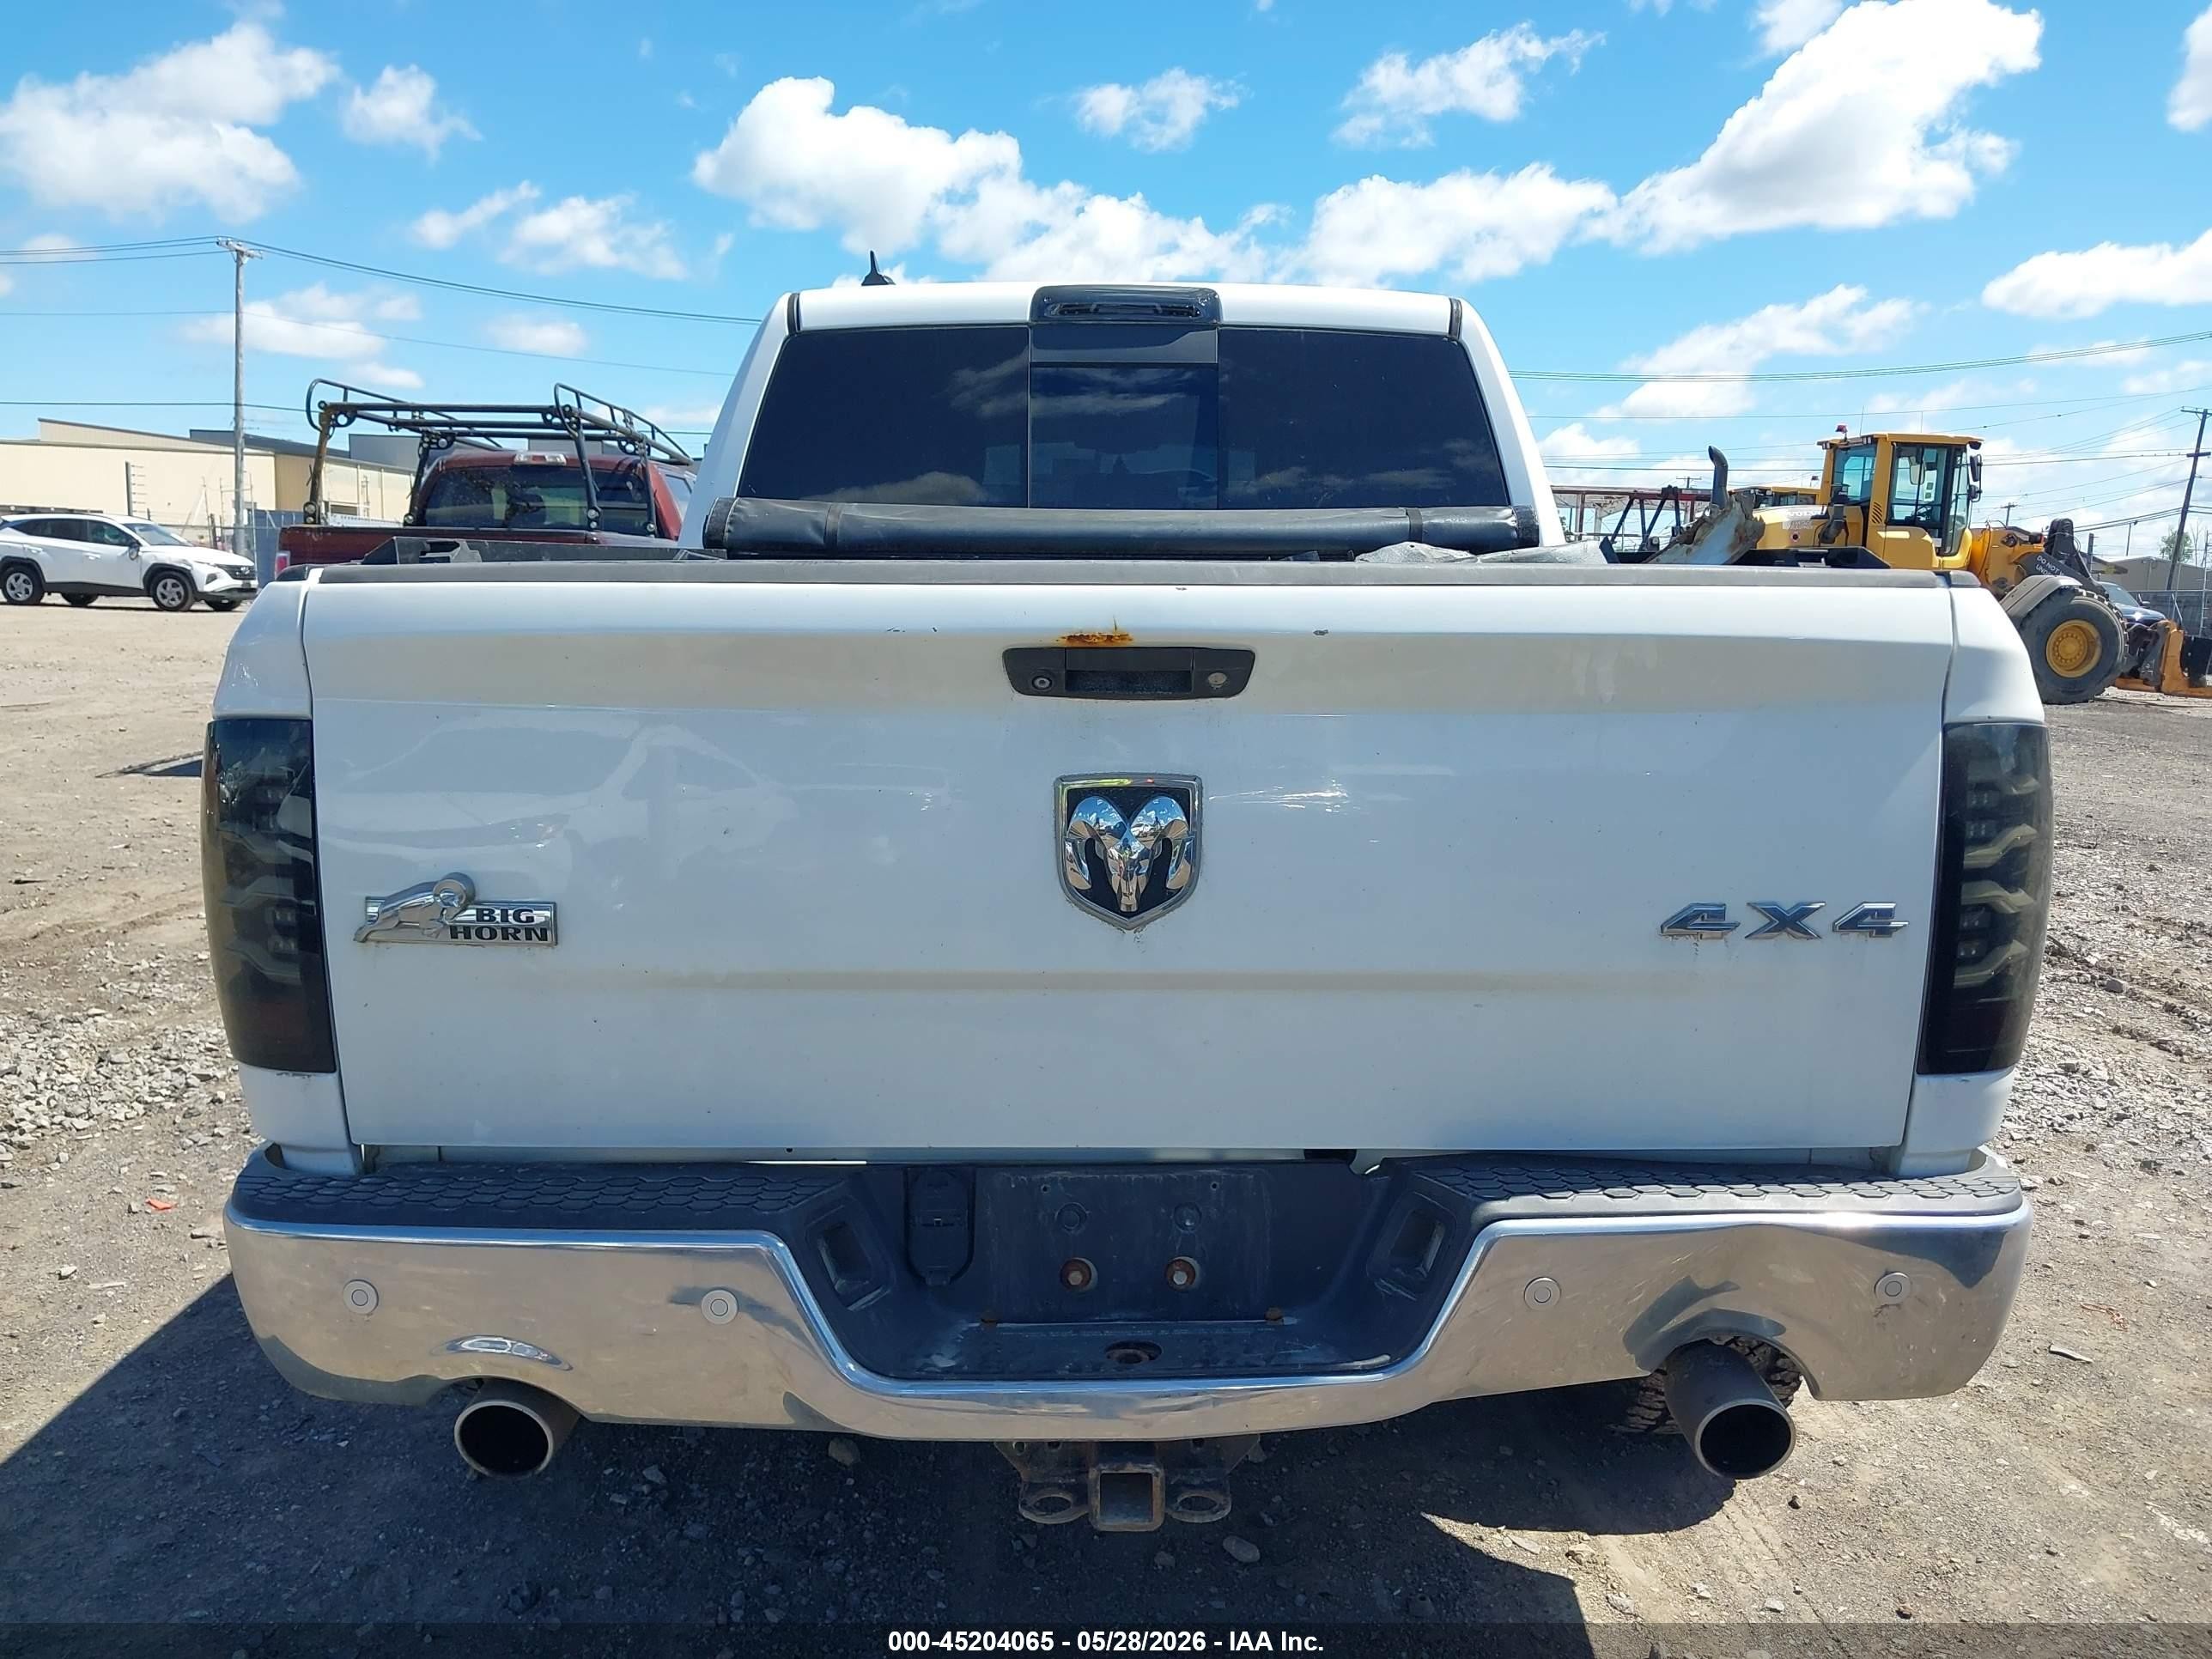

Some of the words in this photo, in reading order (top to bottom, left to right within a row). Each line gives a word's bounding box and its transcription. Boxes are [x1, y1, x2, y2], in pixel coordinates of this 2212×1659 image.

[2035, 564, 2051, 575] UND
[2037, 555, 2047, 564] DO
[2045, 562, 2060, 574] NOT
[476, 908, 536, 924] BIG
[1659, 901, 1910, 939] 4X4
[449, 926, 549, 942] HORN
